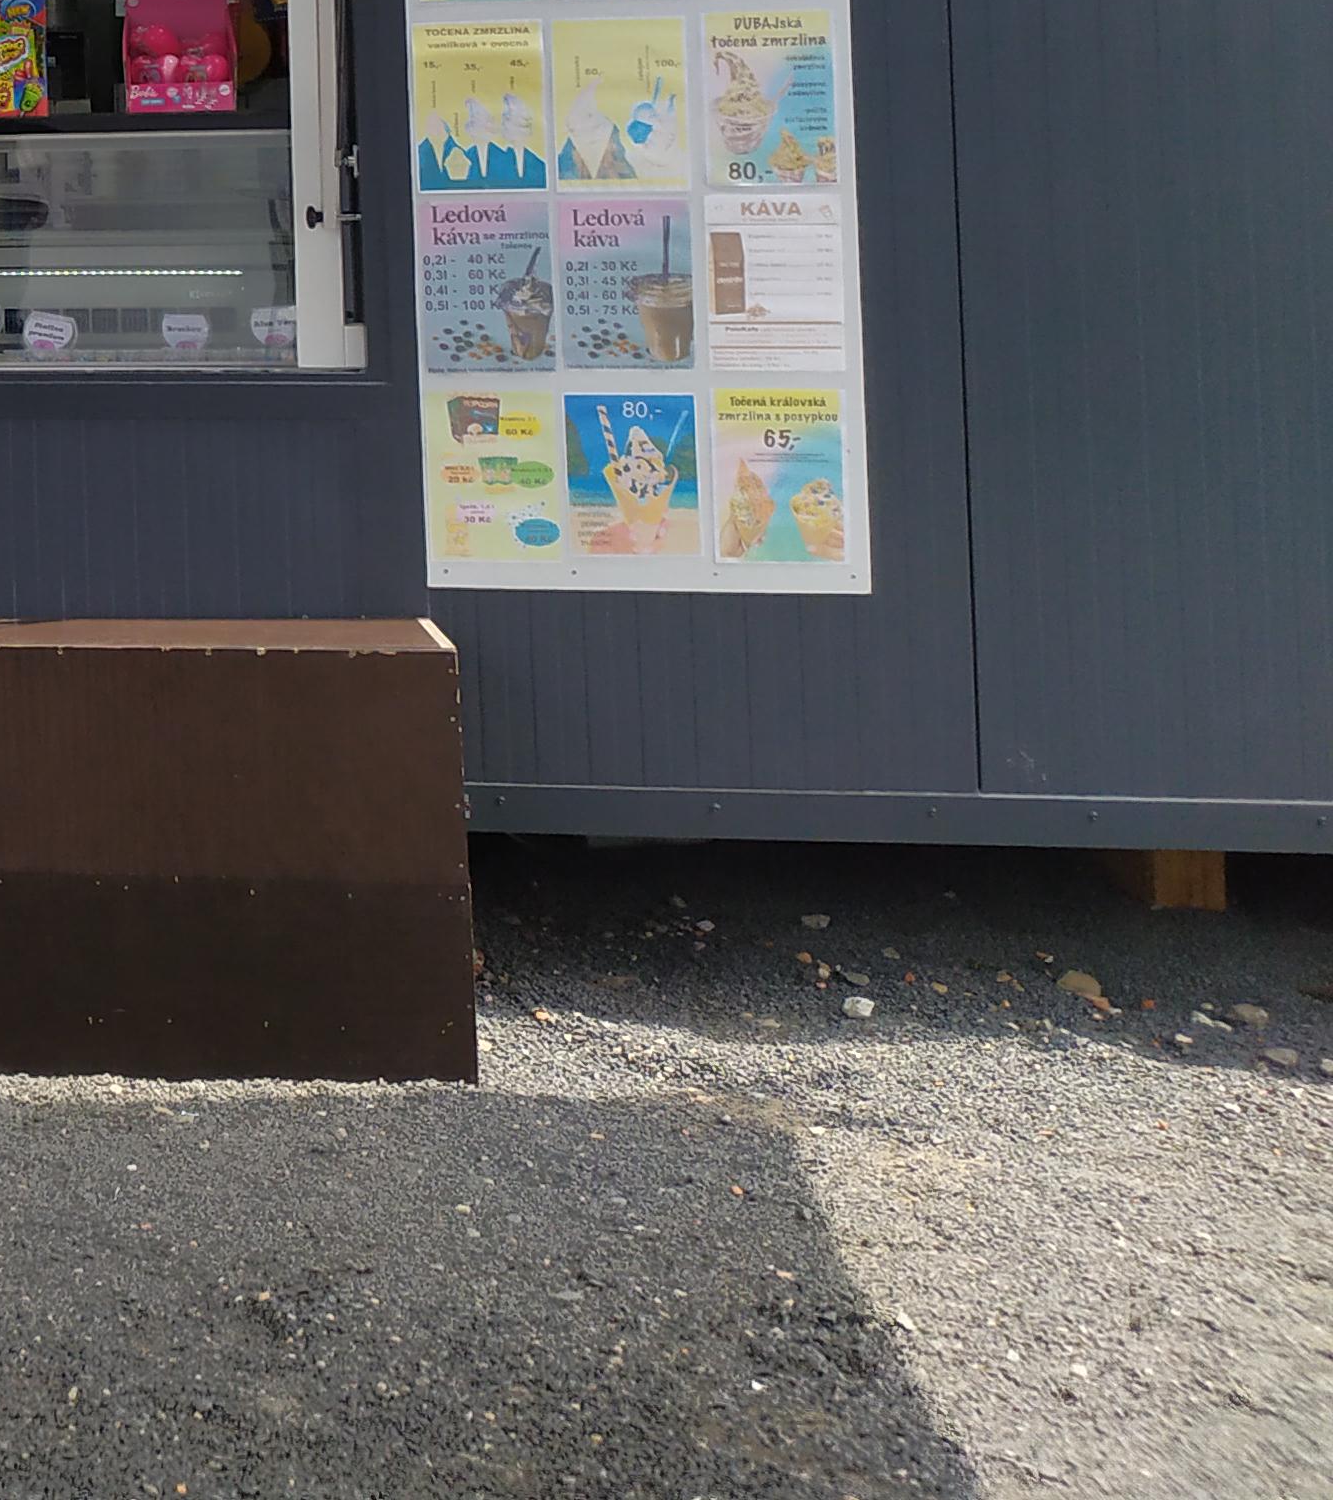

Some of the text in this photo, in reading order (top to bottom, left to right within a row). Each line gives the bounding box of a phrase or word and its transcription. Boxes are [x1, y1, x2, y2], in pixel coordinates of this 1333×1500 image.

[710, 33, 827, 49] točená zmrzlina
[431, 204, 507, 224] Ledová
[740, 199, 802, 216] KÁVA
[572, 208, 645, 227] Ledová
[433, 227, 481, 246] káva
[483, 232, 495, 241] se
[574, 230, 619, 248] káva
[467, 254, 483, 264] 40
[487, 253, 506, 264] Kč
[601, 261, 617, 271] 30
[468, 269, 483, 280] 60
[601, 276, 617, 286] 45
[601, 290, 617, 300] 60
[463, 300, 486, 311] 100
[602, 305, 618, 315] 75
[622, 401, 663, 420] 80,-
[718, 411, 772, 421] zmrzlina
[783, 411, 838, 423] posypkou
[763, 428, 801, 451] 65,-
